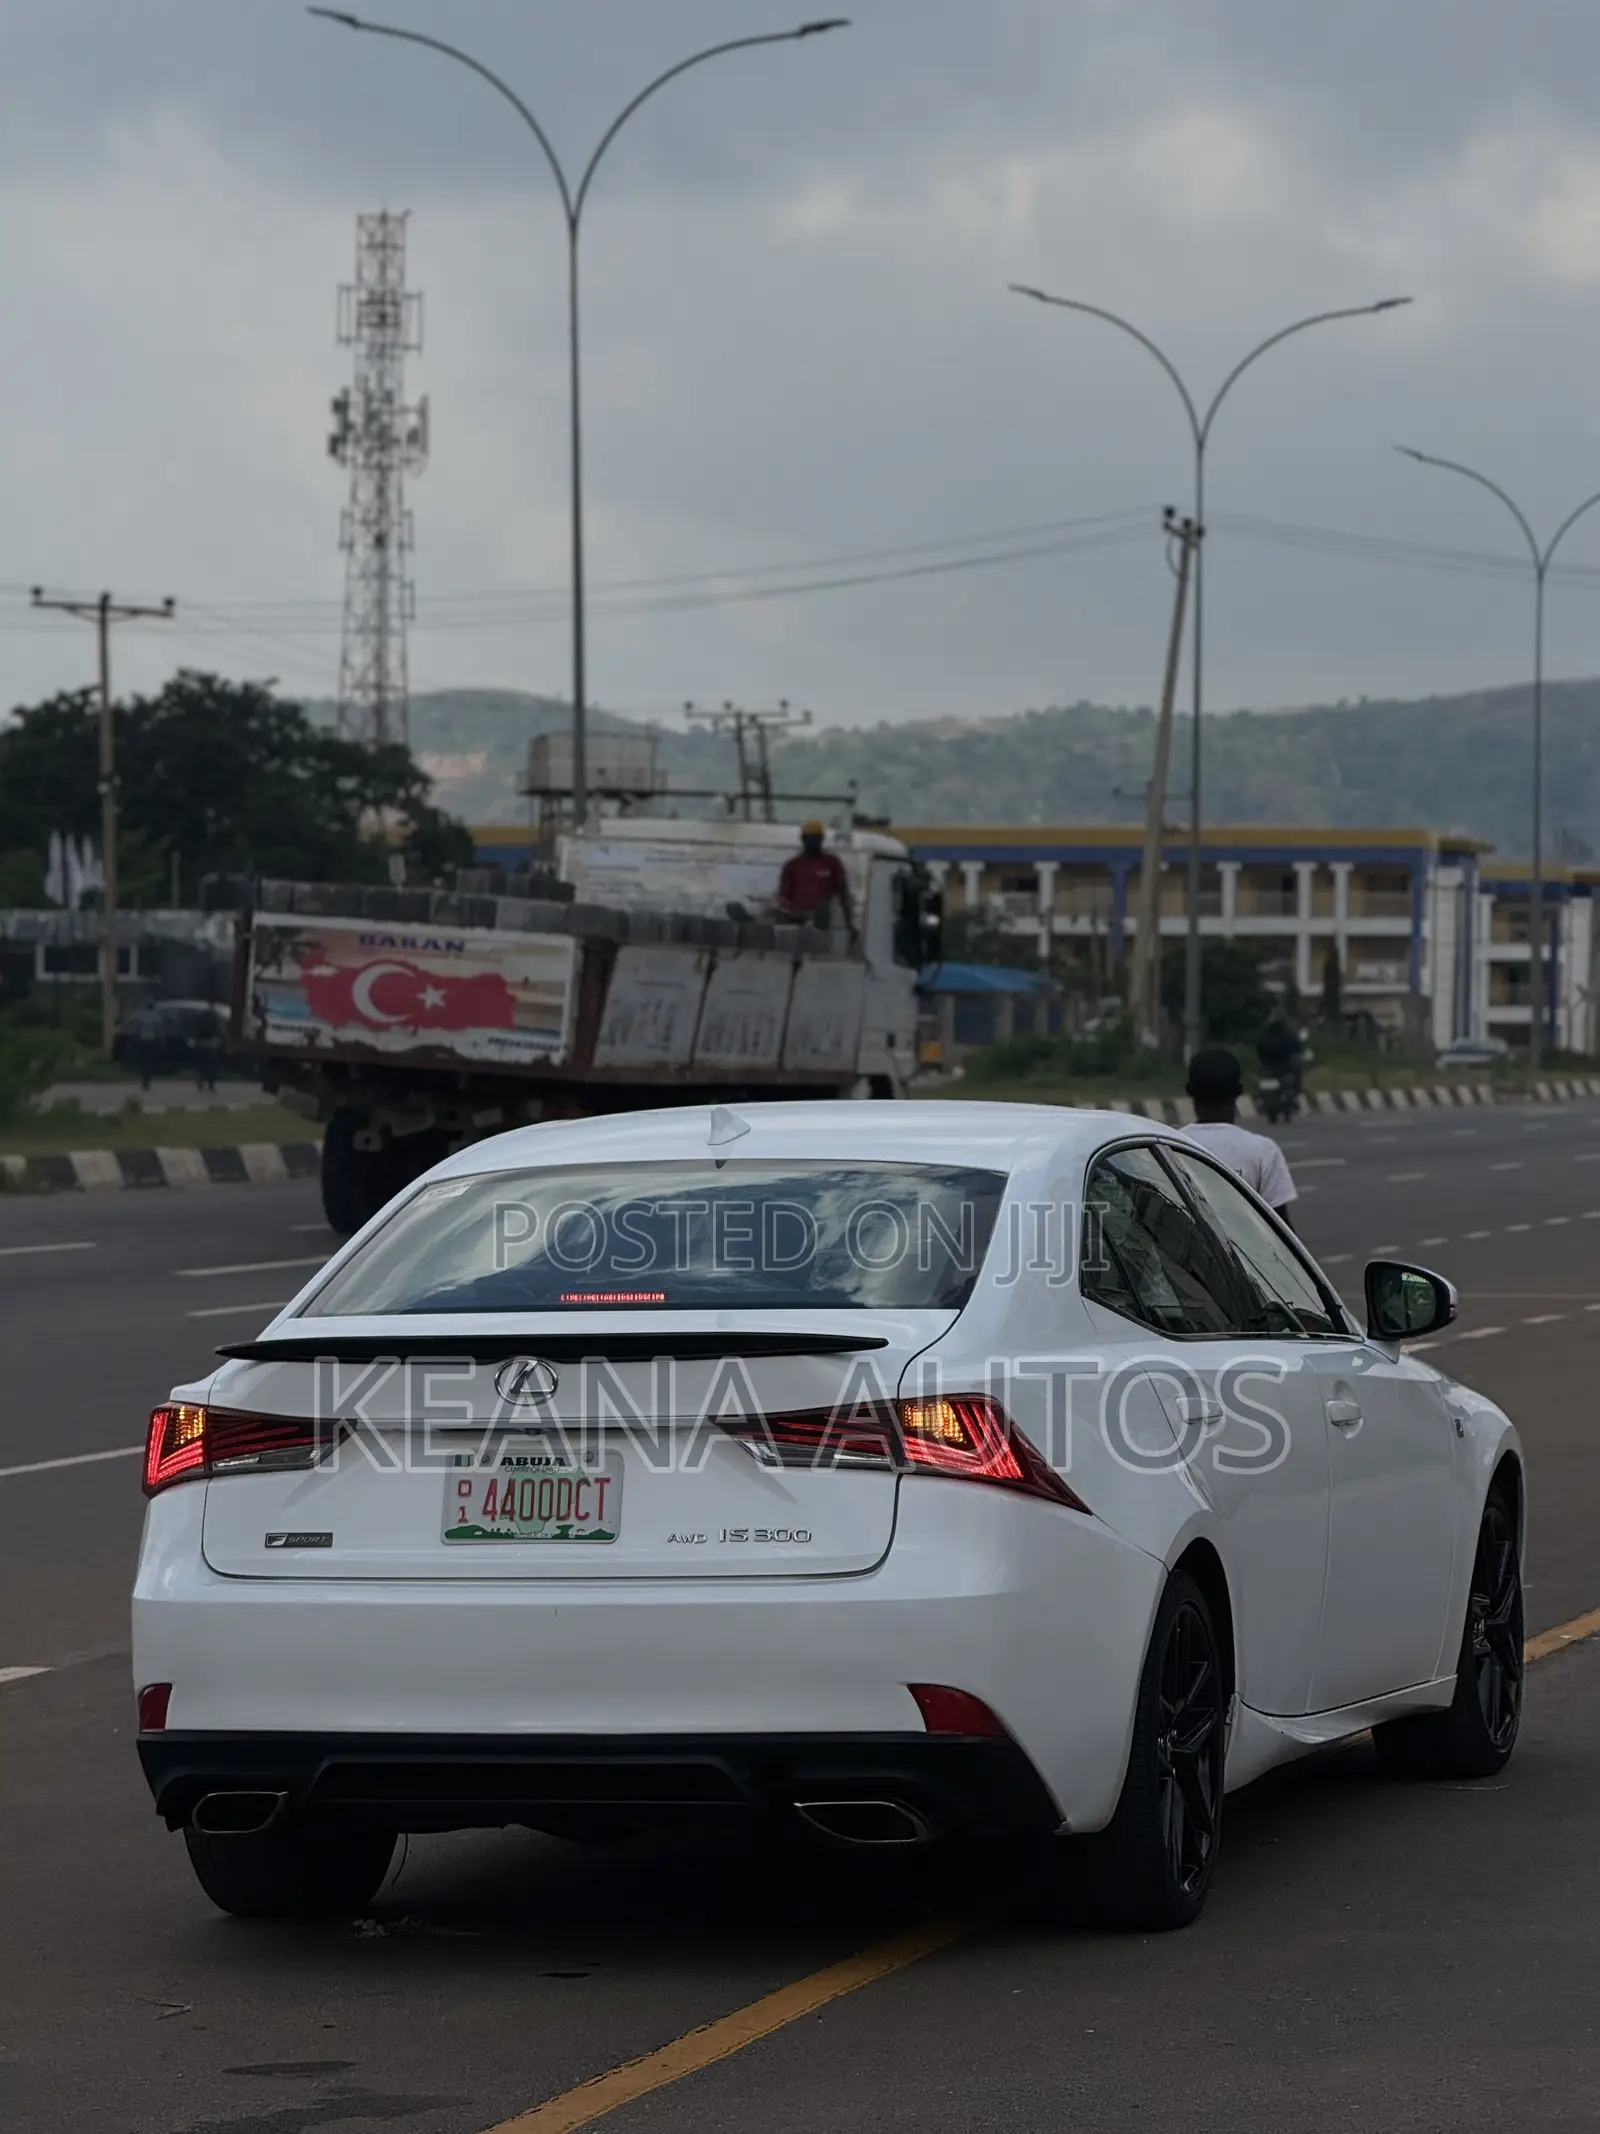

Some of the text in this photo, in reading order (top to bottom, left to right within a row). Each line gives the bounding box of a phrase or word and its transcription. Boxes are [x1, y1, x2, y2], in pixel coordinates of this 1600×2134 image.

[359, 933, 466, 954] BARAN
[500, 1456, 567, 1467] ABUJA
[482, 1477, 611, 1521] 4400DCT
[667, 1528, 812, 1544] AWD IS 300
